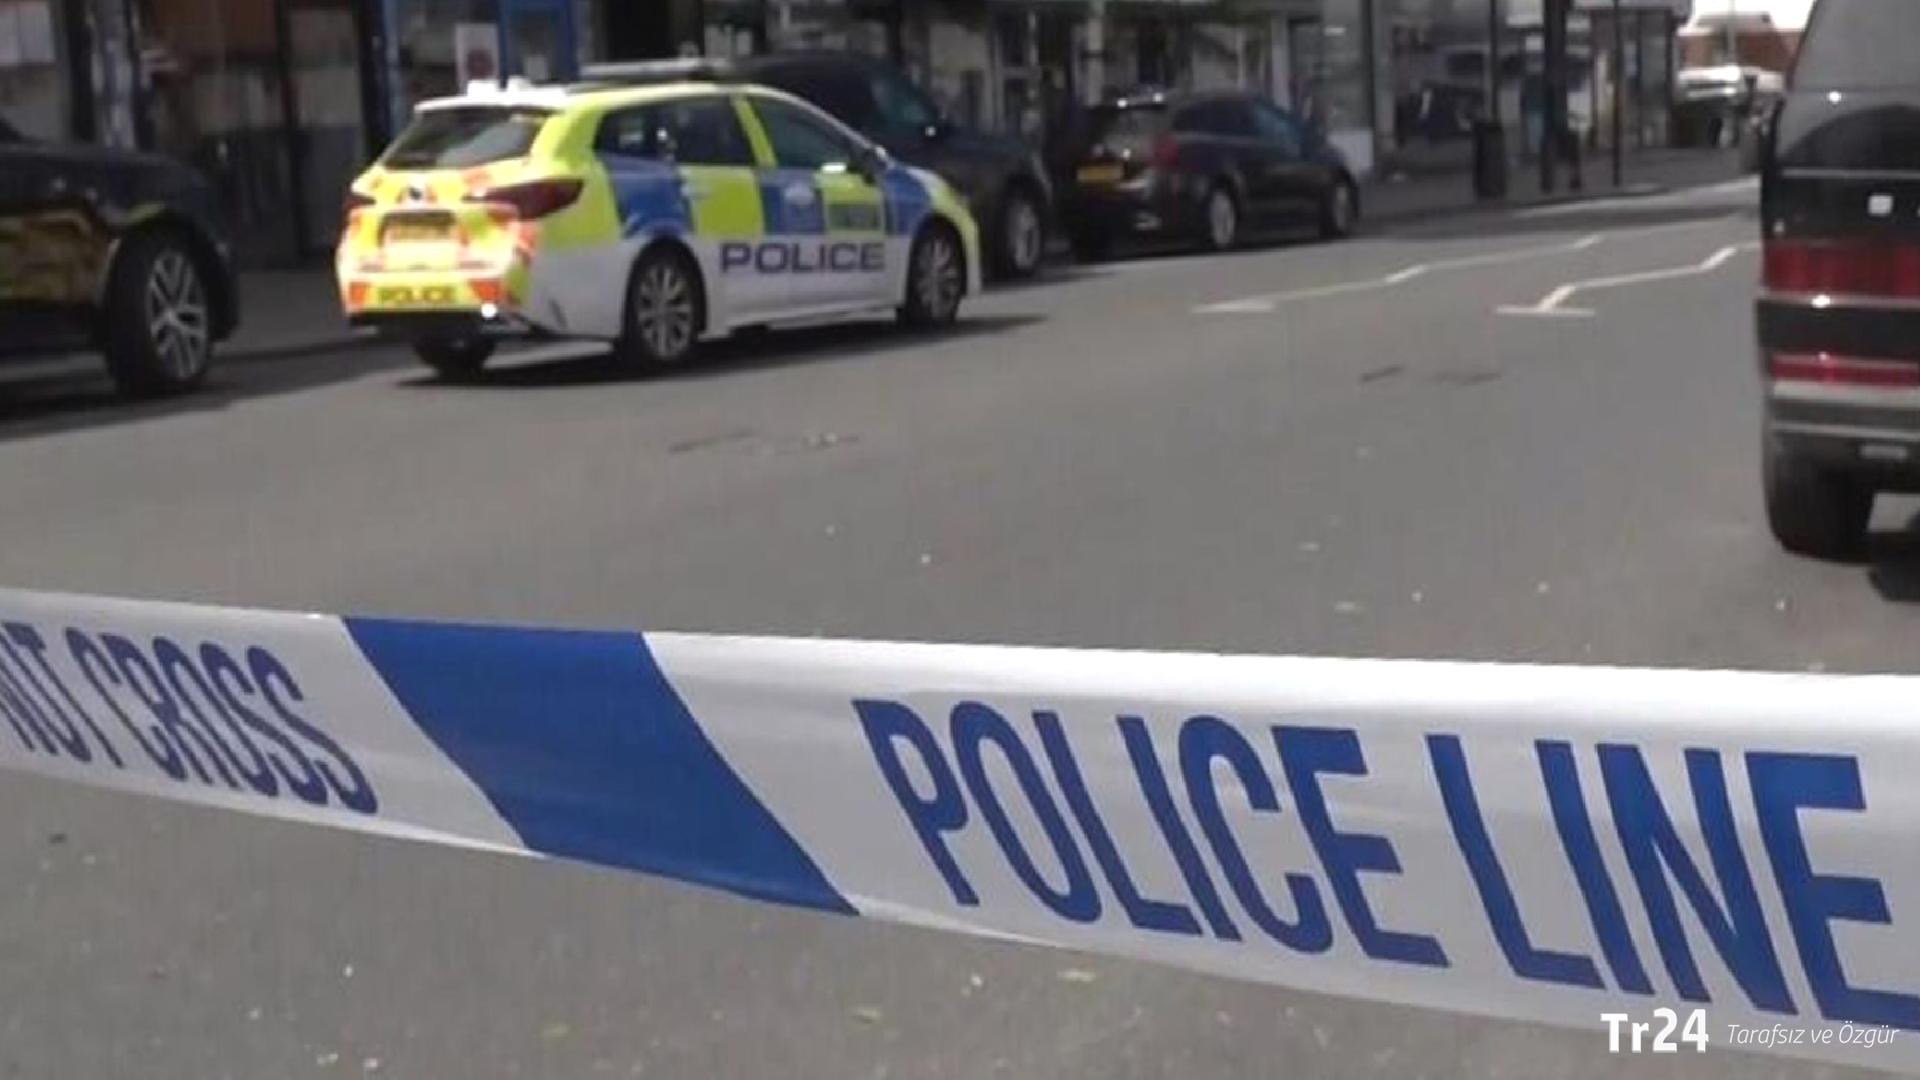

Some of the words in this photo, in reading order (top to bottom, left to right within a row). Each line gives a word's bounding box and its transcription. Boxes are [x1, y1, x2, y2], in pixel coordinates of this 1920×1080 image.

[378, 286, 456, 304] POLICE
[719, 241, 886, 273] POLICE
[65, 626, 378, 814] CROSS
[851, 699, 1451, 968] POLICE
[1424, 734, 1920, 1030] LINE
